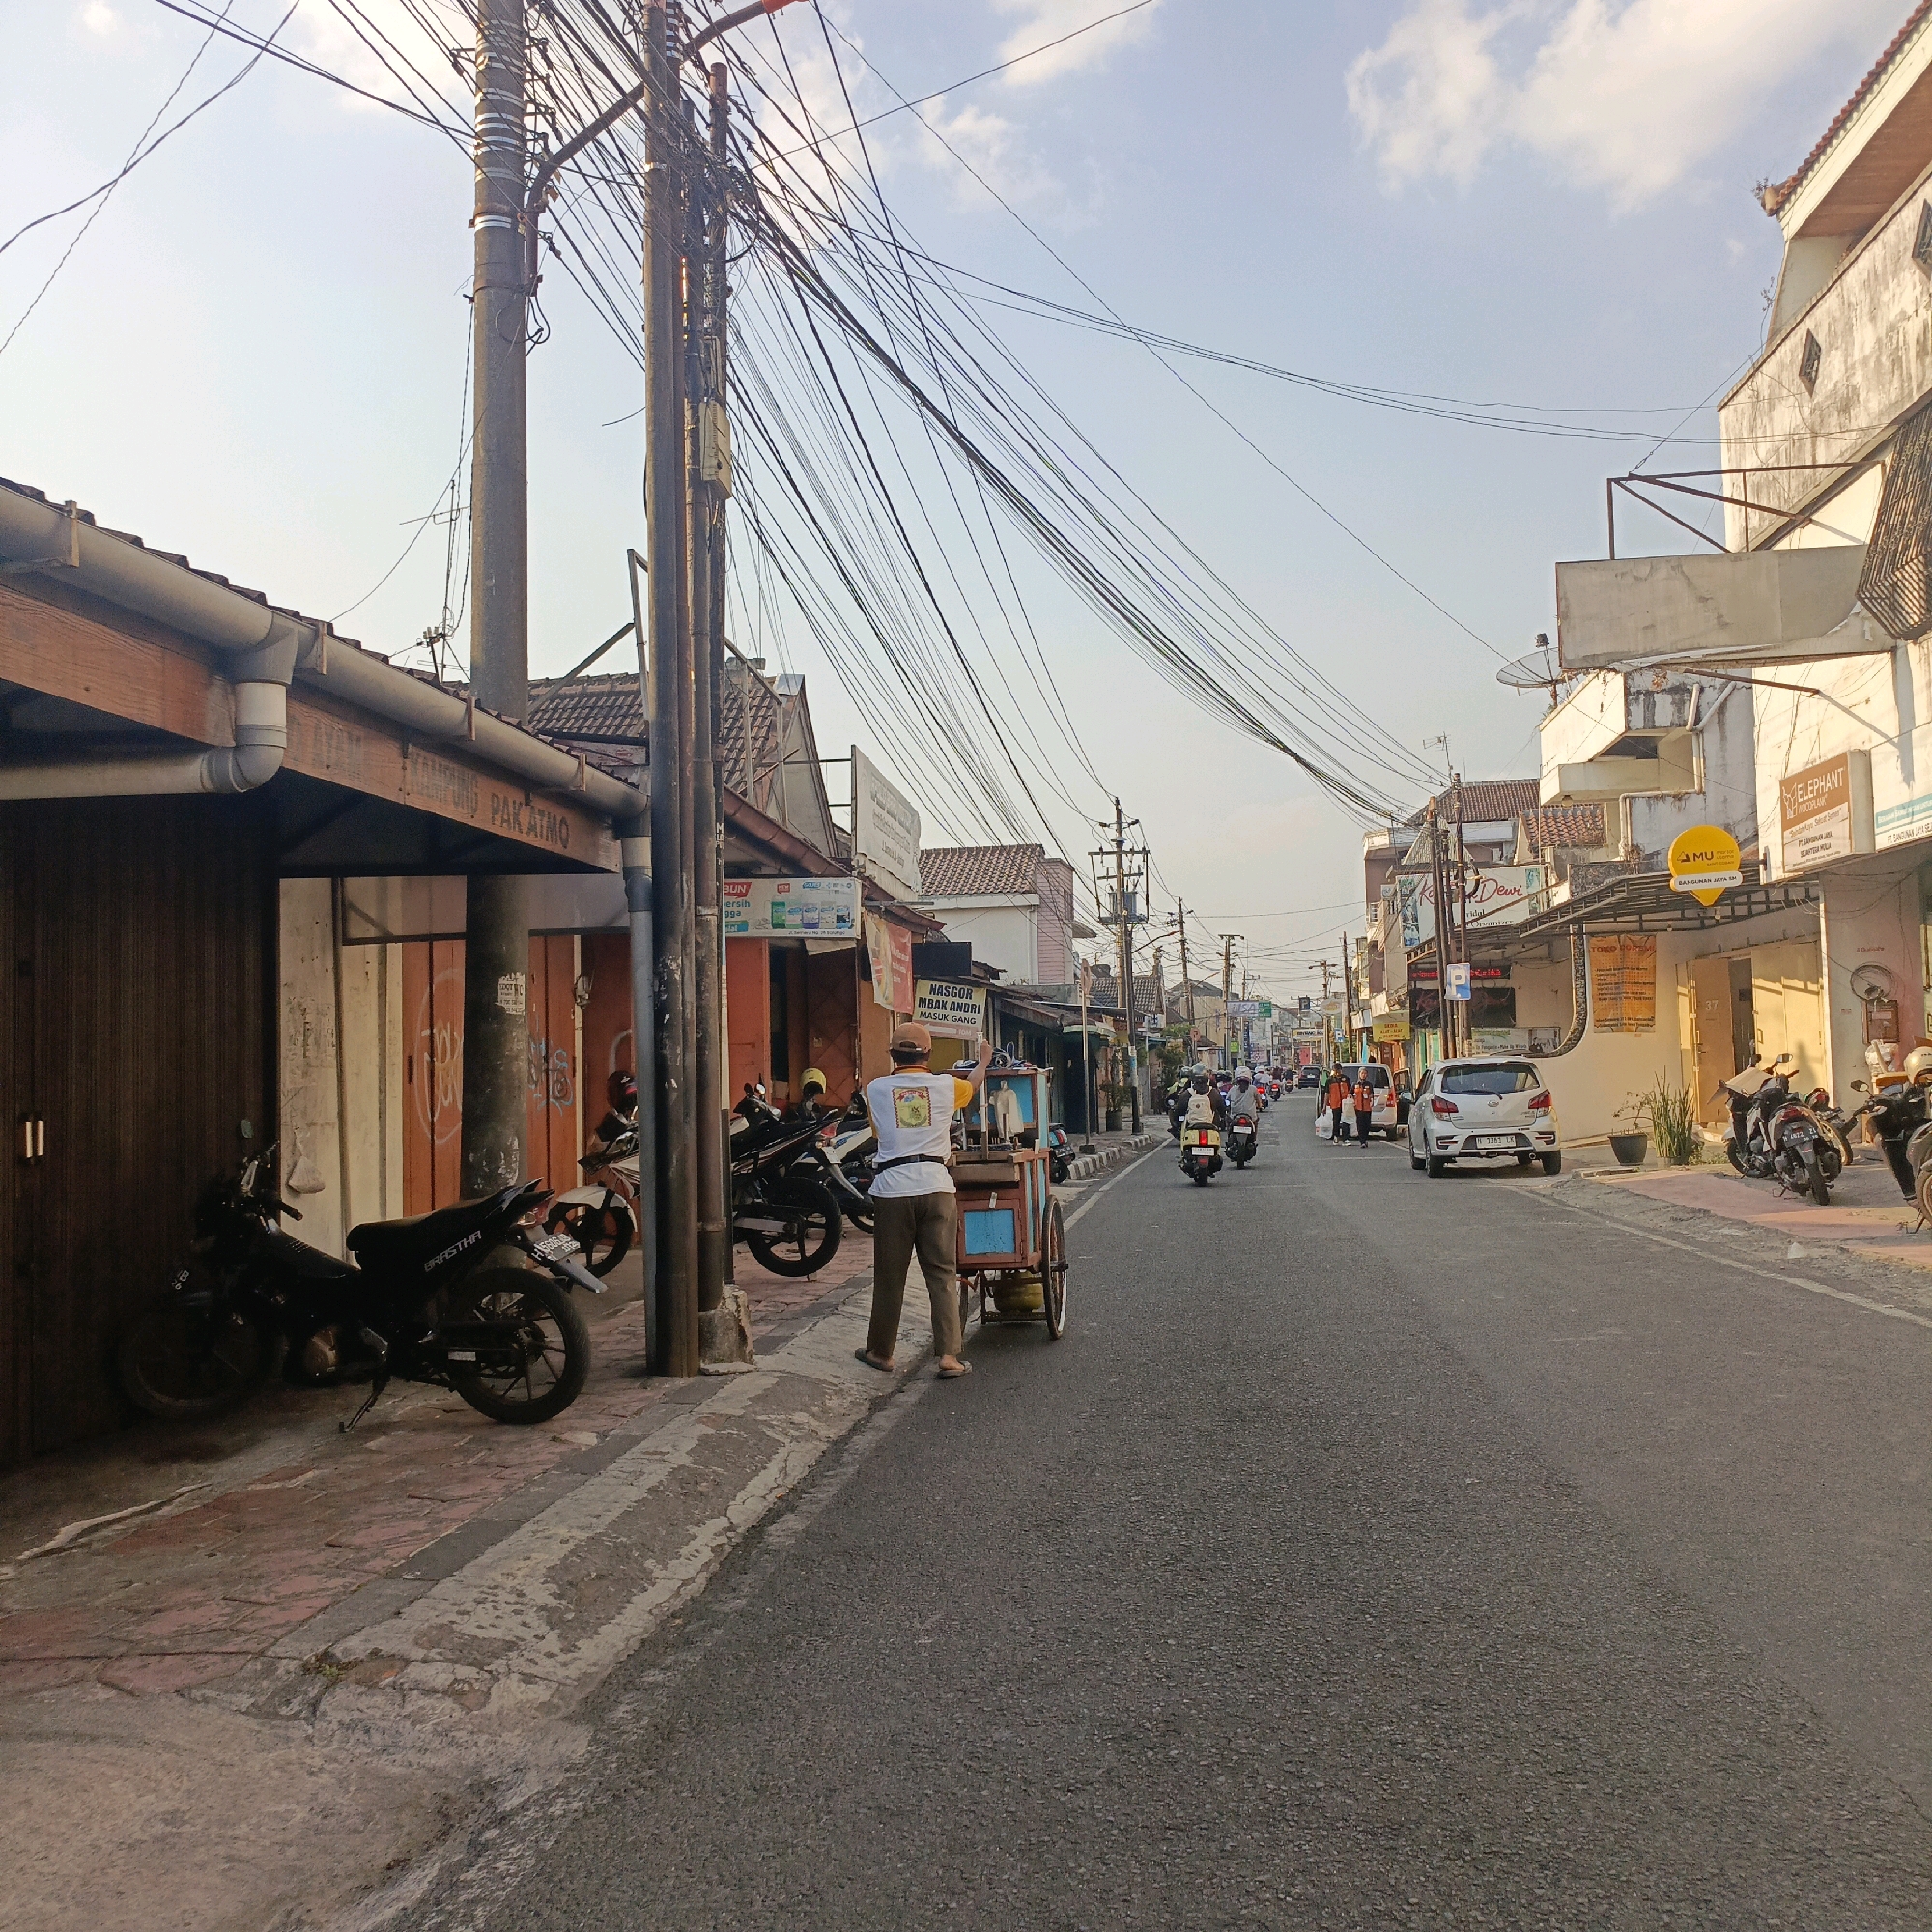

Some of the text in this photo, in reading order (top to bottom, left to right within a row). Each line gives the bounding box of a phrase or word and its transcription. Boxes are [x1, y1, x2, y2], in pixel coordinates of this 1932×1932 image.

[1798, 767, 1844, 803] ELEPHANT
[491, 793, 523, 833] PAK
[1475, 878, 1523, 904] Dewi
[929, 983, 974, 1000] NASGOR
[1451, 969, 1465, 996] P
[918, 996, 980, 1015] MBAK ANDRI
[1705, 999, 1719, 1011] 37
[919, 1010, 977, 1025] MASUK GANG
